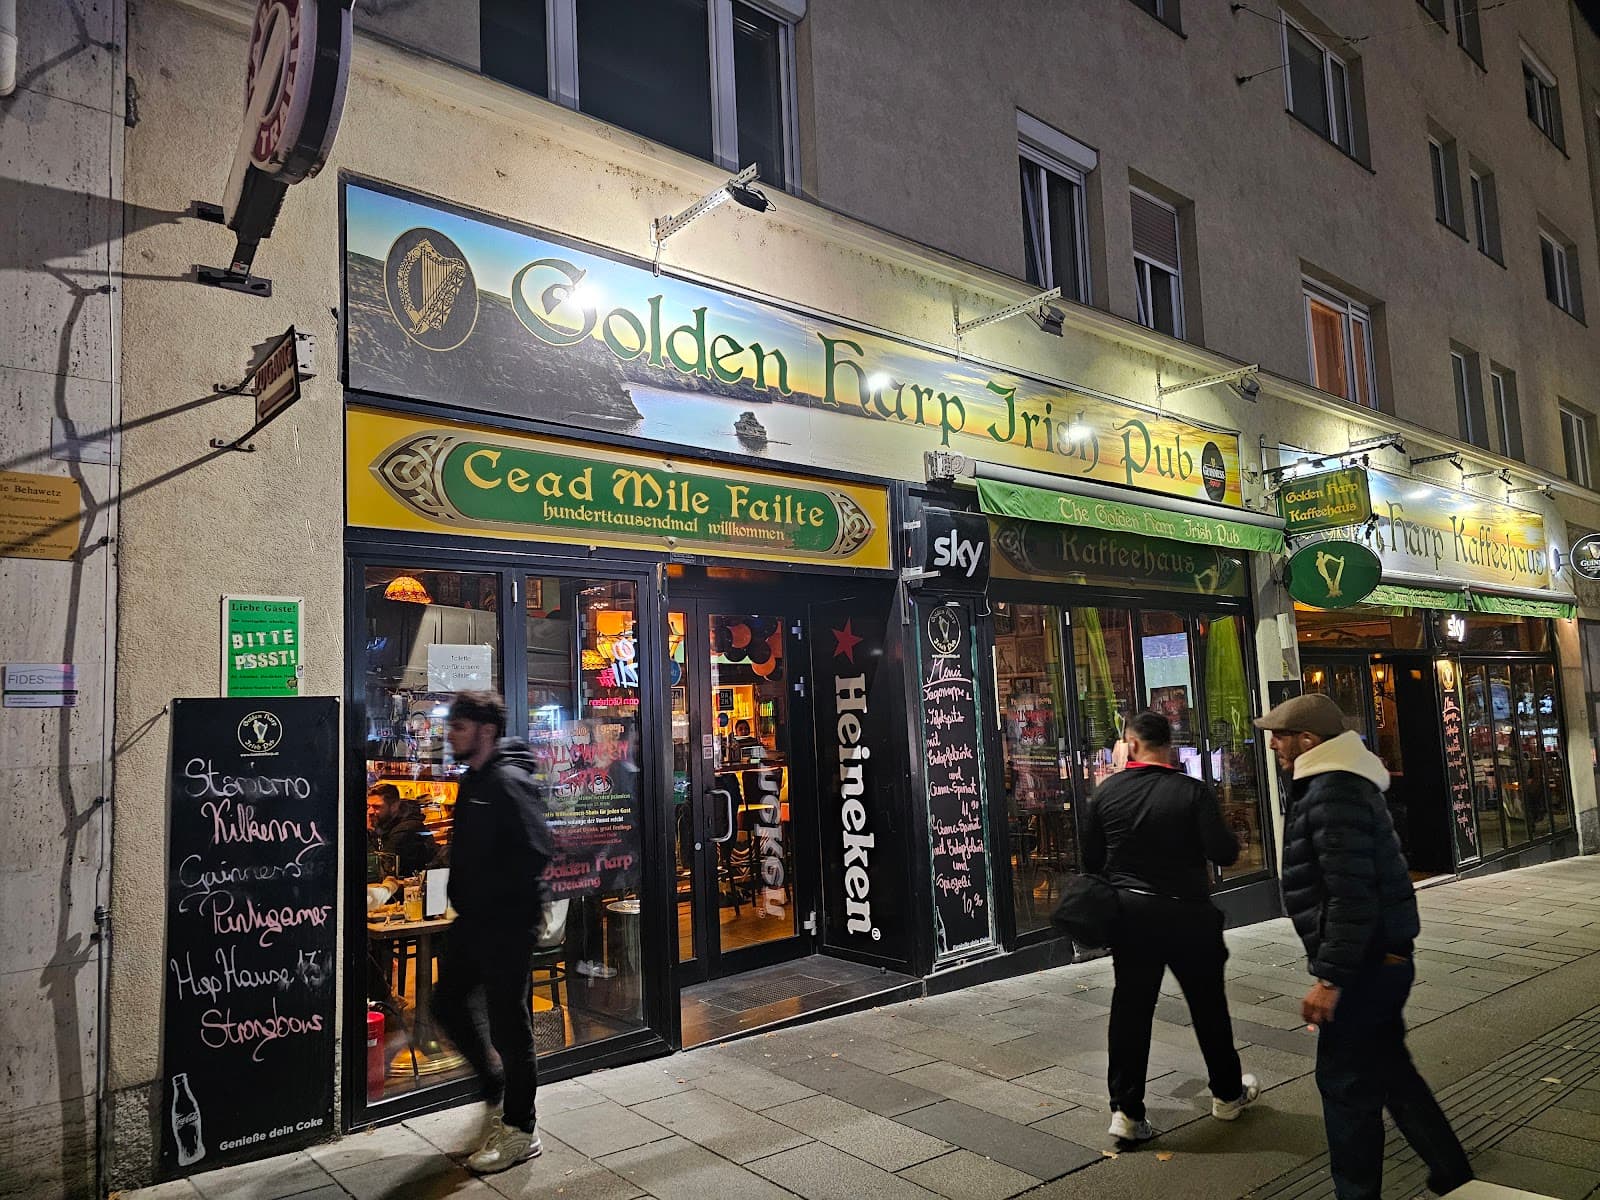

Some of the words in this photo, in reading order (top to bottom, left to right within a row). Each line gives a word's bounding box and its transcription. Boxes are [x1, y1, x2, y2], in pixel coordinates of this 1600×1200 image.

[510, 257, 792, 397] Golden
[816, 331, 966, 448] Harp
[986, 380, 1099, 474] Irish
[1112, 419, 1193, 485] Pub
[463, 449, 593, 502] Cead
[612, 468, 710, 513] Mile
[725, 484, 825, 527] Failte
[1285, 489, 1323, 503] Golden
[1326, 482, 1358, 496] Harp
[542, 500, 699, 533] hunderttausendmal
[707, 519, 785, 542] willkommen
[1058, 497, 1089, 525] The
[1095, 505, 1140, 528] Golden
[1143, 512, 1176, 536] Harp
[1183, 519, 1212, 543] Irish
[1214, 524, 1240, 545] Pub
[1288, 502, 1357, 522] Kaffeehaus
[934, 529, 984, 577] sky
[1060, 530, 1196, 576] Kaffeehaus
[1386, 500, 1444, 571] Harp
[1449, 515, 1544, 581] Kaffeehaus
[231, 603, 260, 612] Liebe
[232, 629, 294, 649] BITTE
[1447, 614, 1465, 642] sky
[235, 650, 296, 670] PSSST!
[8, 674, 45, 685] FIDES
[835, 673, 875, 935] Heineken
[219, 1133, 266, 1150] Genieße
[269, 1125, 293, 1138] dein
[295, 1118, 323, 1131] Coke
